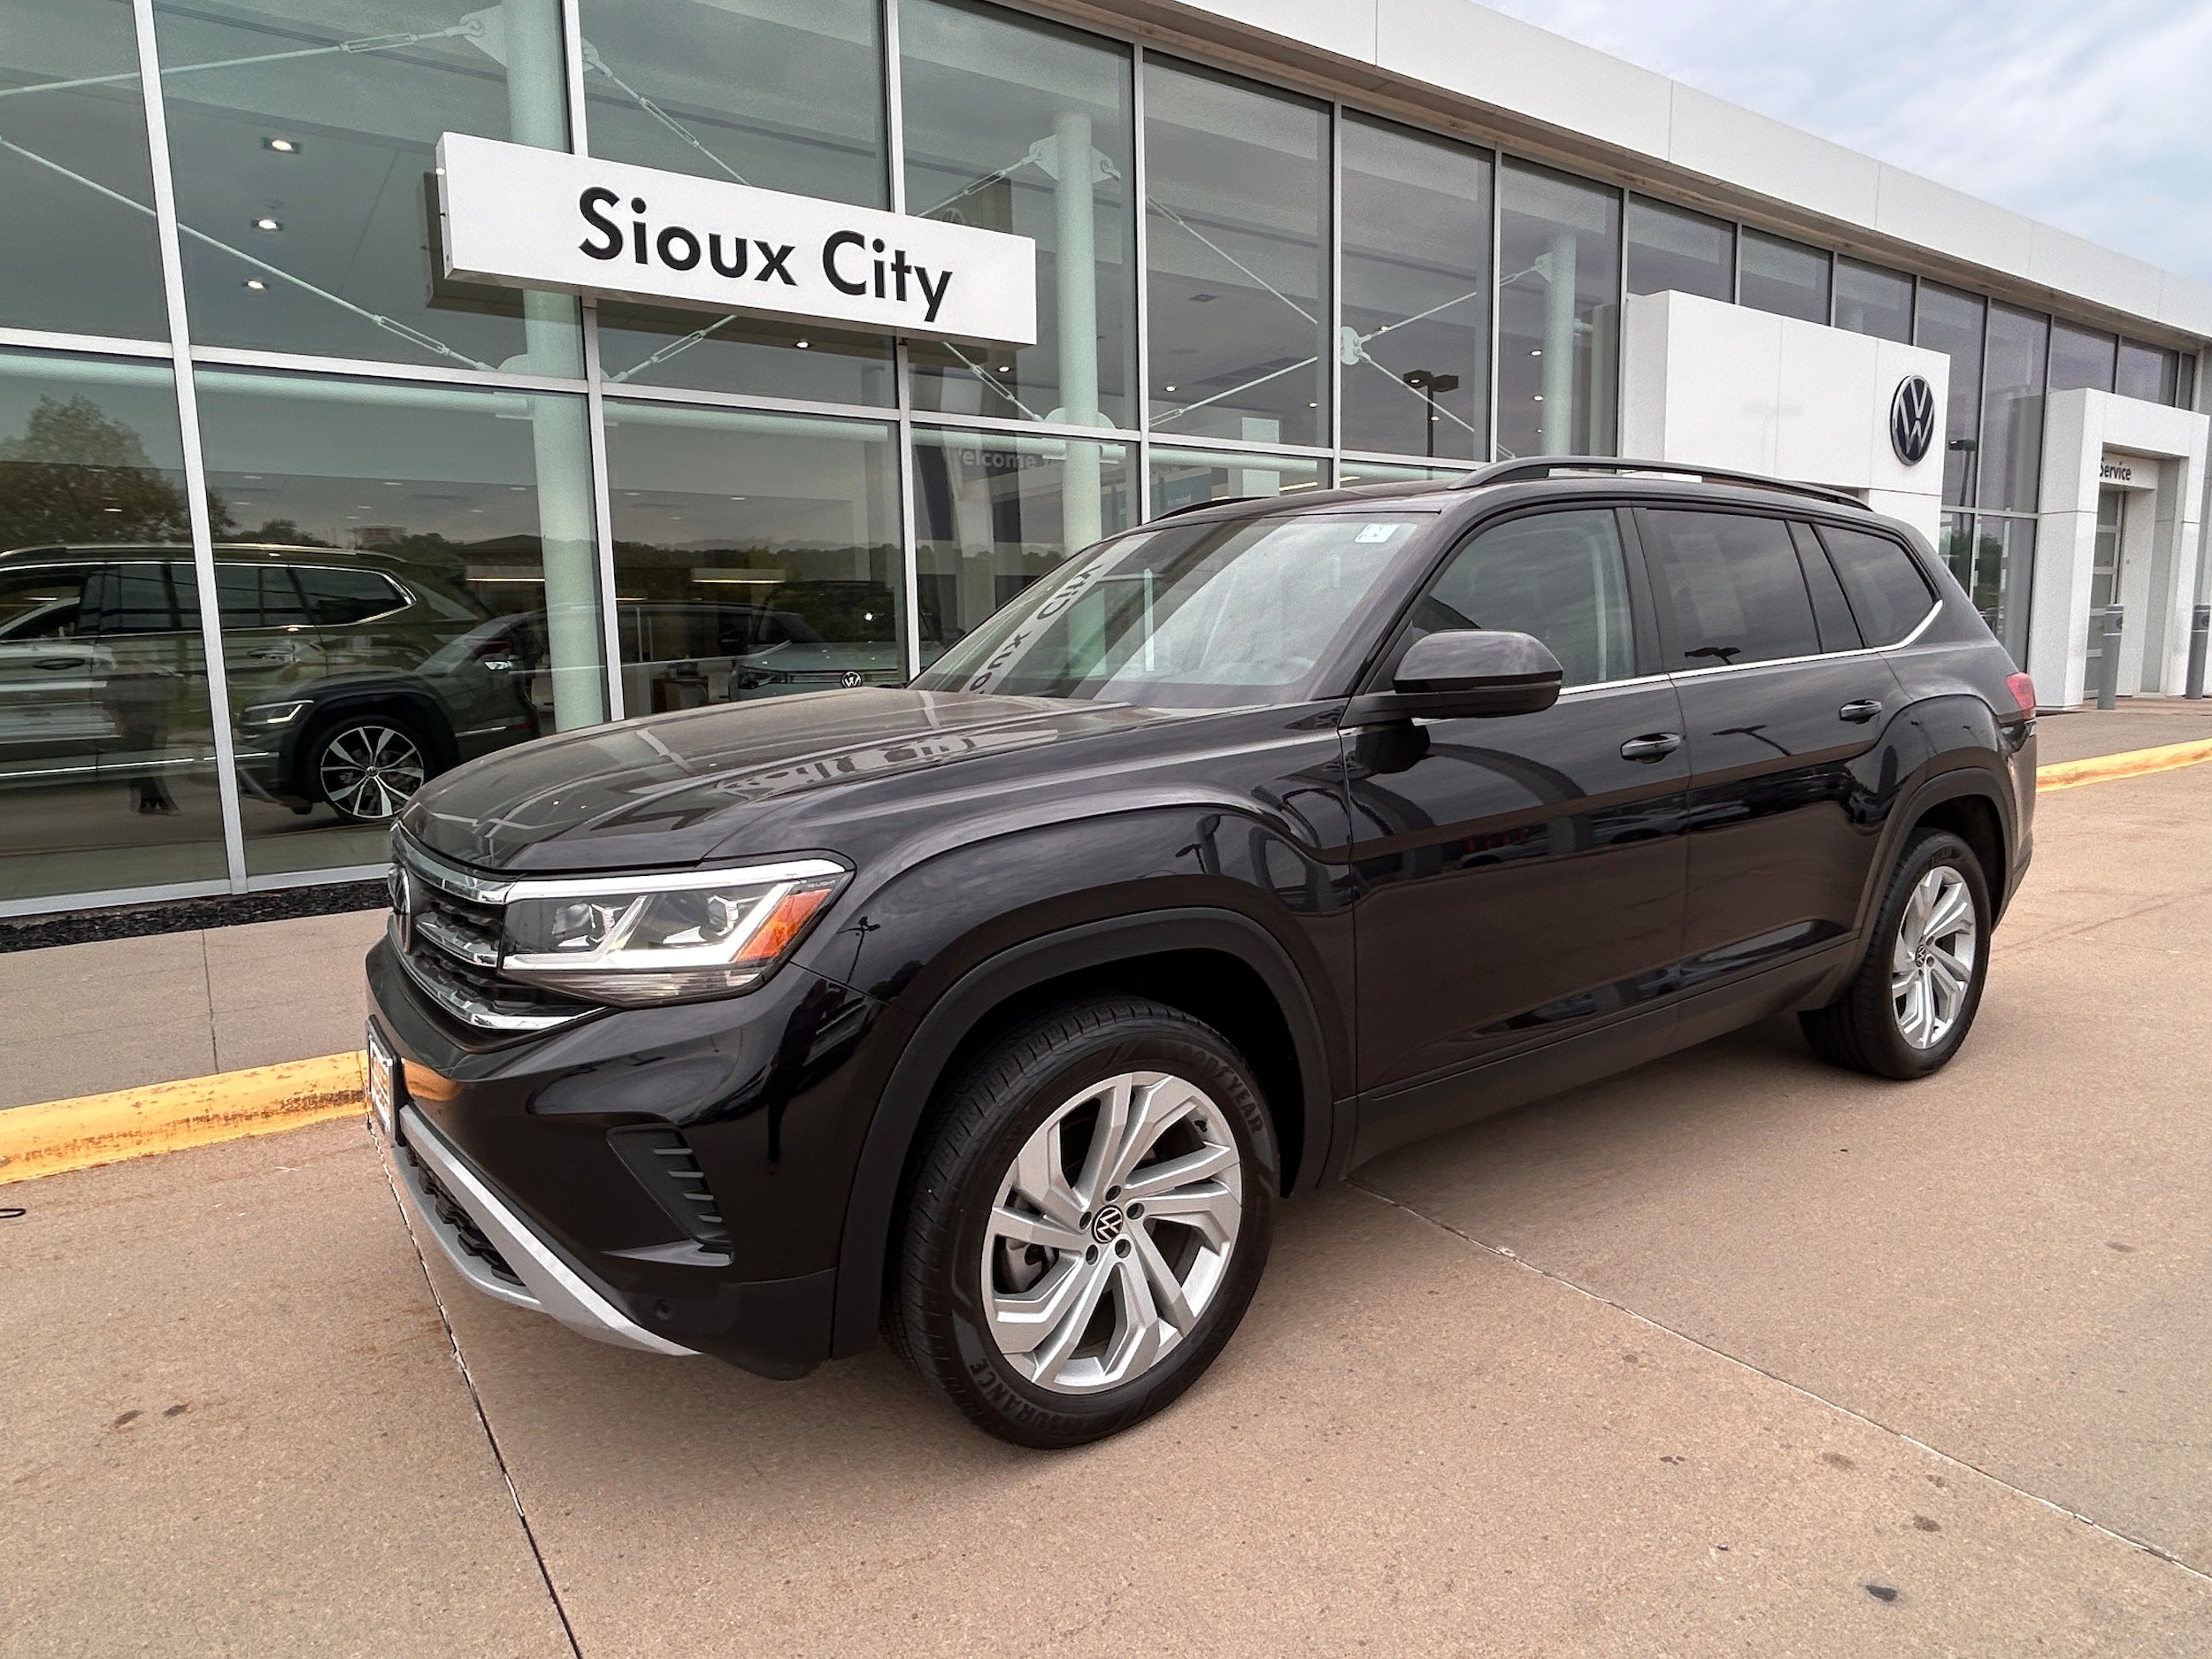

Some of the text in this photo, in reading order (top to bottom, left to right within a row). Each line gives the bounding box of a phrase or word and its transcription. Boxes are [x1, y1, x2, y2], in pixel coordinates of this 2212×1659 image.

[578, 187, 953, 323] Sioux City
[955, 449, 1036, 469] elcome
